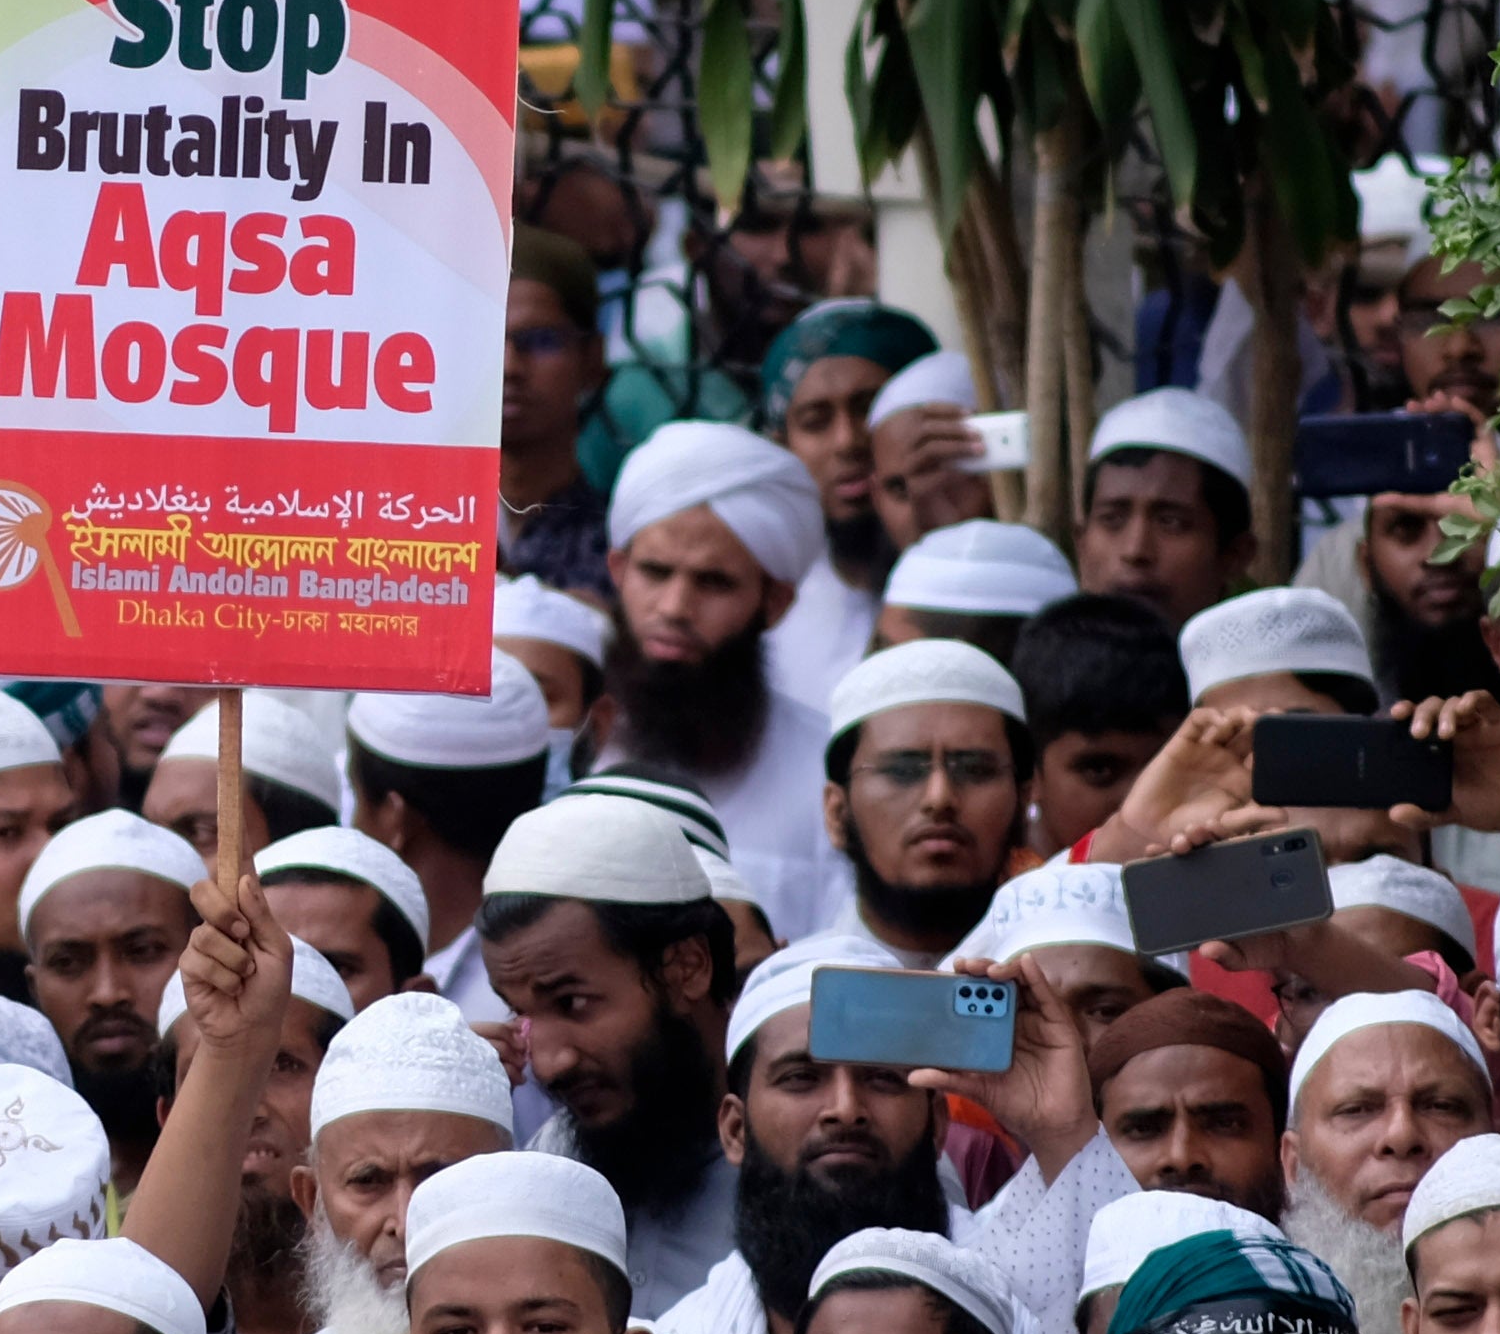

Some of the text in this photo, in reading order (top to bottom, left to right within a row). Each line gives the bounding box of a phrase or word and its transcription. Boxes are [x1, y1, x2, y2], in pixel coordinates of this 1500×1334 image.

[16, 88, 432, 202] Brutality In
[75, 181, 357, 317] Aqsa
[70, 481, 476, 530] الحركة الإسلامية بنغلاديش
[63, 510, 481, 575] ইসলামী আন্দোলন বাংলাদেশ
[70, 560, 469, 608] Islami Andolan Bangladesh
[117, 599, 206, 629] Dhaka
[337, 611, 421, 638] মহানগর
